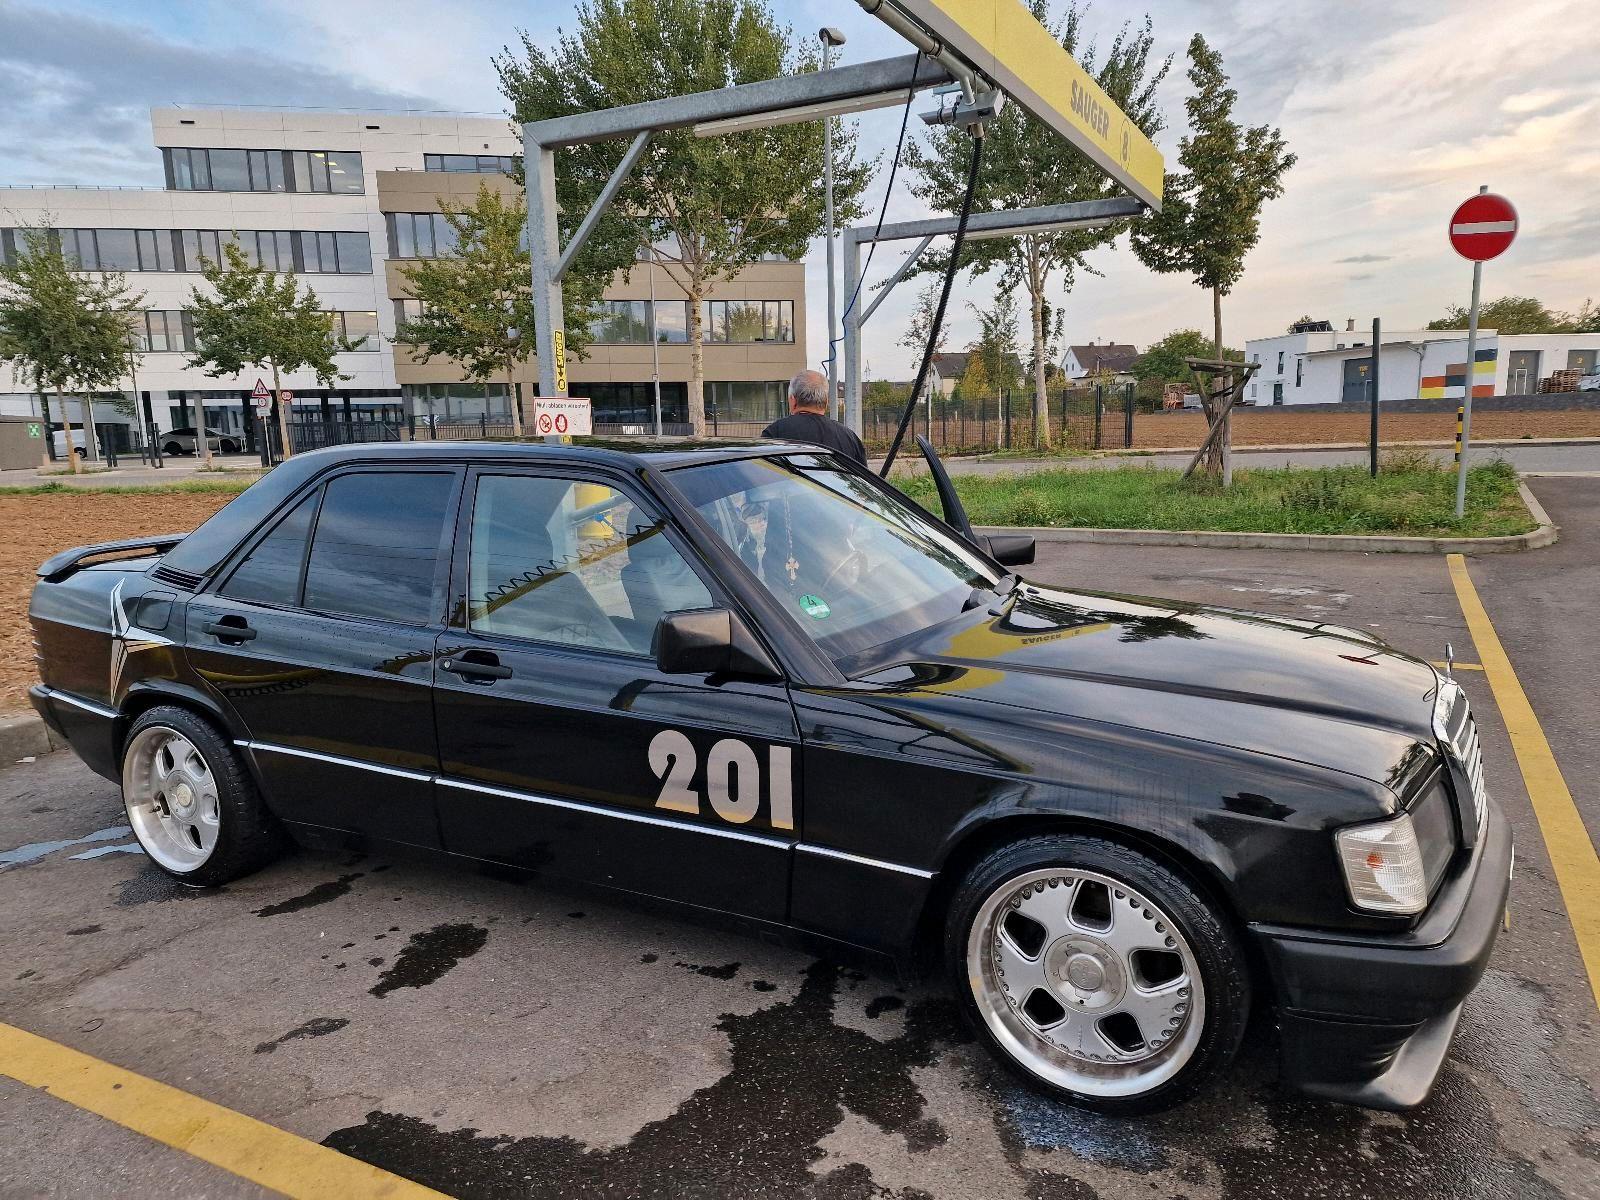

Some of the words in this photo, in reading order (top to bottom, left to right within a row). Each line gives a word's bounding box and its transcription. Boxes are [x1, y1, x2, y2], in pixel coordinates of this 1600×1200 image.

[1070, 80, 1109, 141] SAUGER
[1122, 131, 1129, 161] 8
[806, 595, 817, 606] 4
[647, 729, 794, 831] 201
